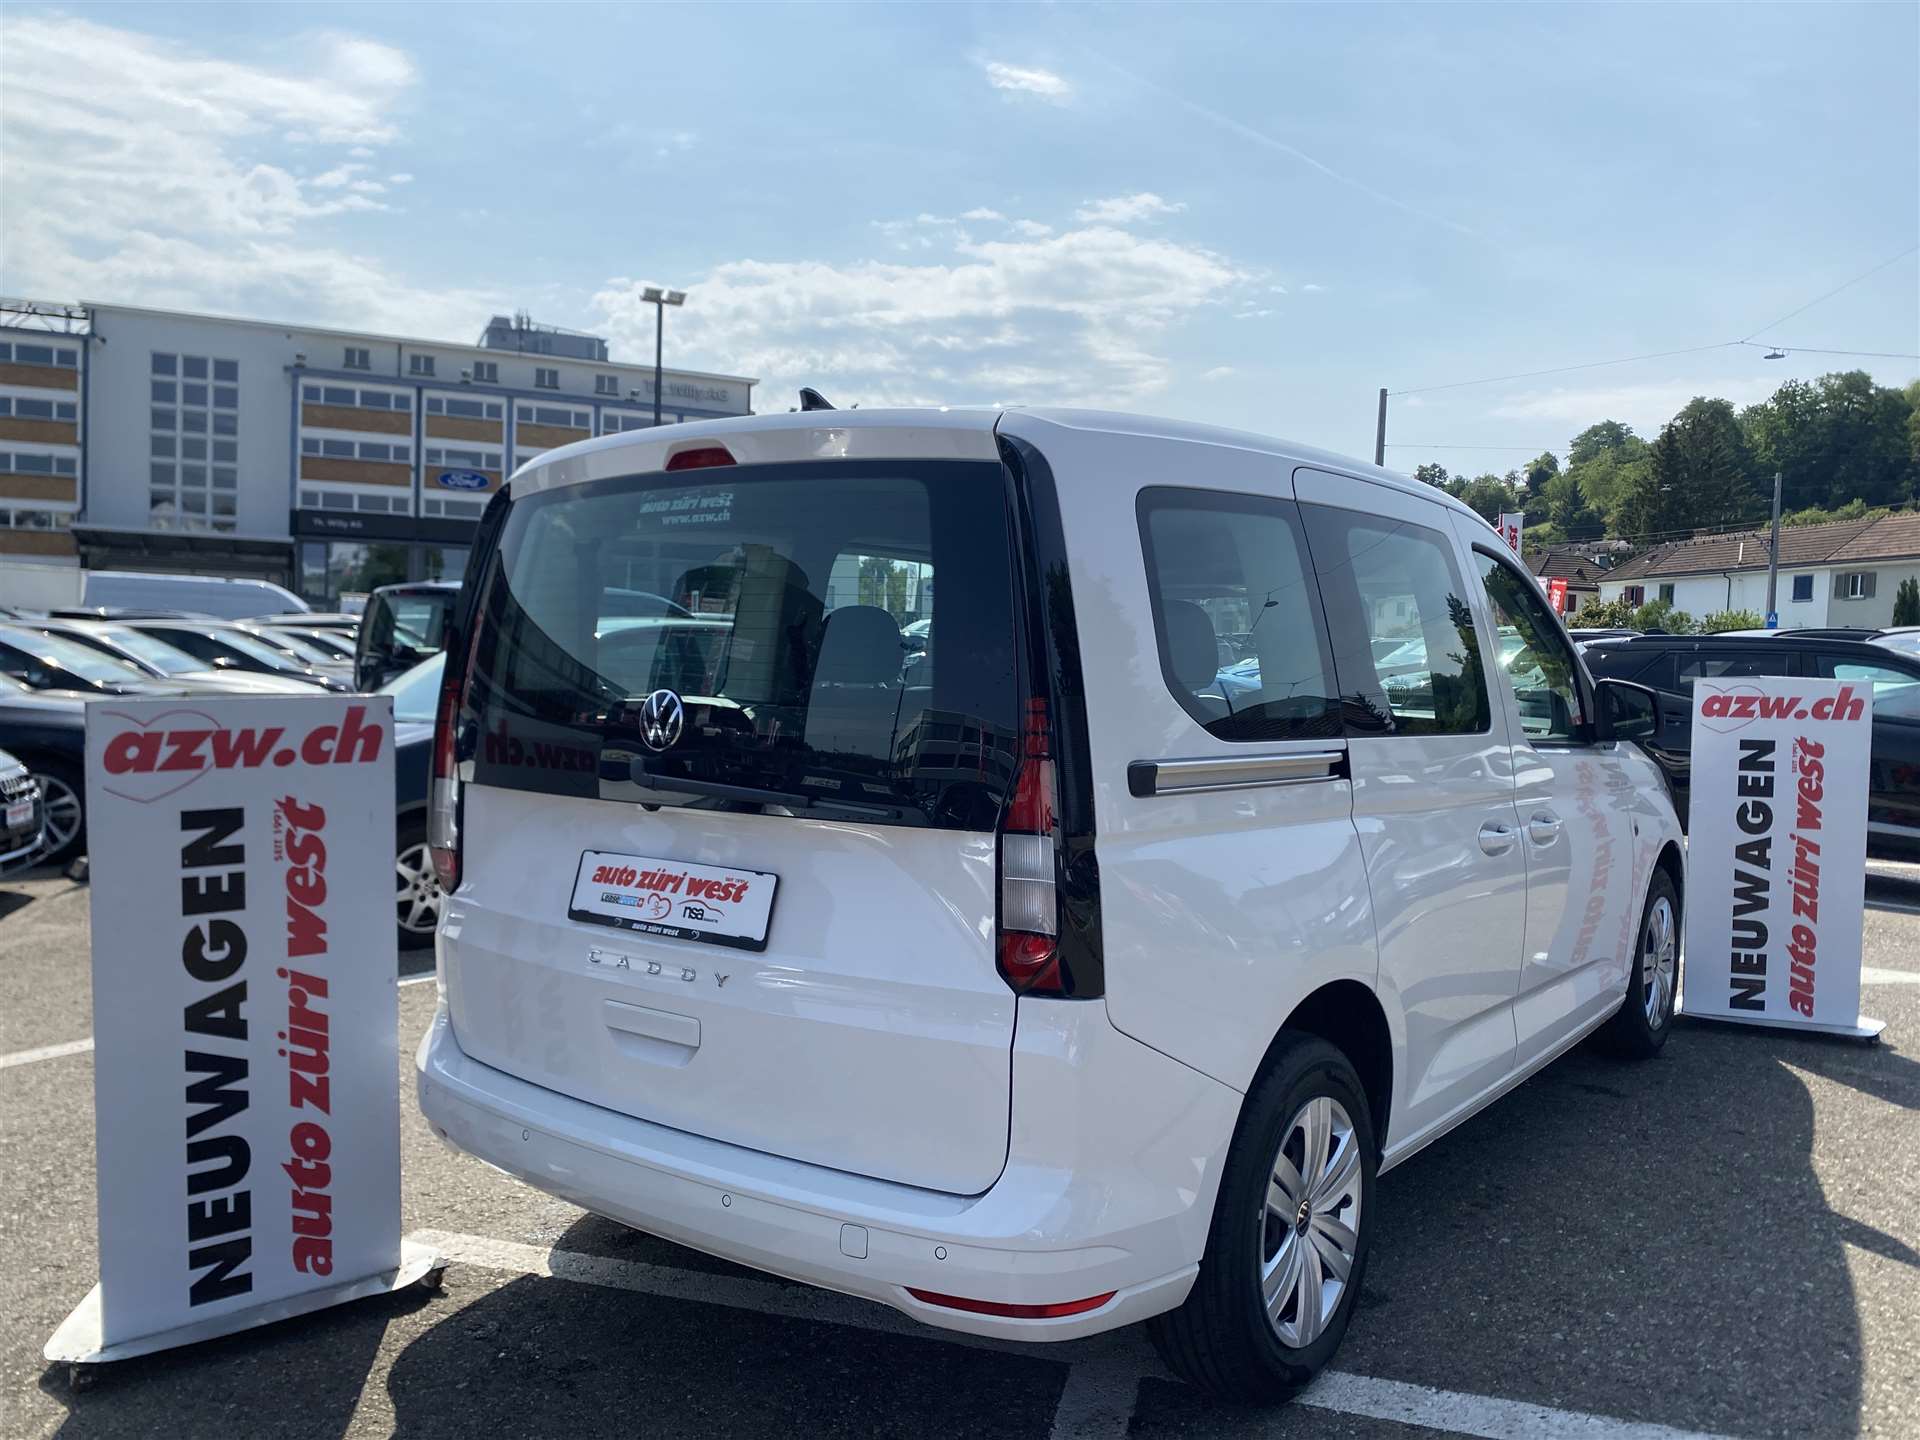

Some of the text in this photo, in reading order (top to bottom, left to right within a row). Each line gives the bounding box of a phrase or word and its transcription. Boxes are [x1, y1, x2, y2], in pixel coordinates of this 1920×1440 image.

[640, 500, 669, 513] auto
[661, 508, 731, 525] www.azw.ch
[1701, 686, 1865, 721] azw.ch
[103, 705, 384, 776] azw.ch
[273, 840, 283, 862] SEIT
[592, 864, 750, 903] auto züri west
[1729, 738, 1776, 1012] NEUWAGEN
[1786, 735, 1825, 1018] auto züri west
[631, 922, 680, 937] auto züri west
[683, 906, 704, 921] nsa
[588, 950, 730, 987] CADDY
[274, 795, 334, 1277] auto züri west
[180, 806, 253, 1308] NEUWAGEN
